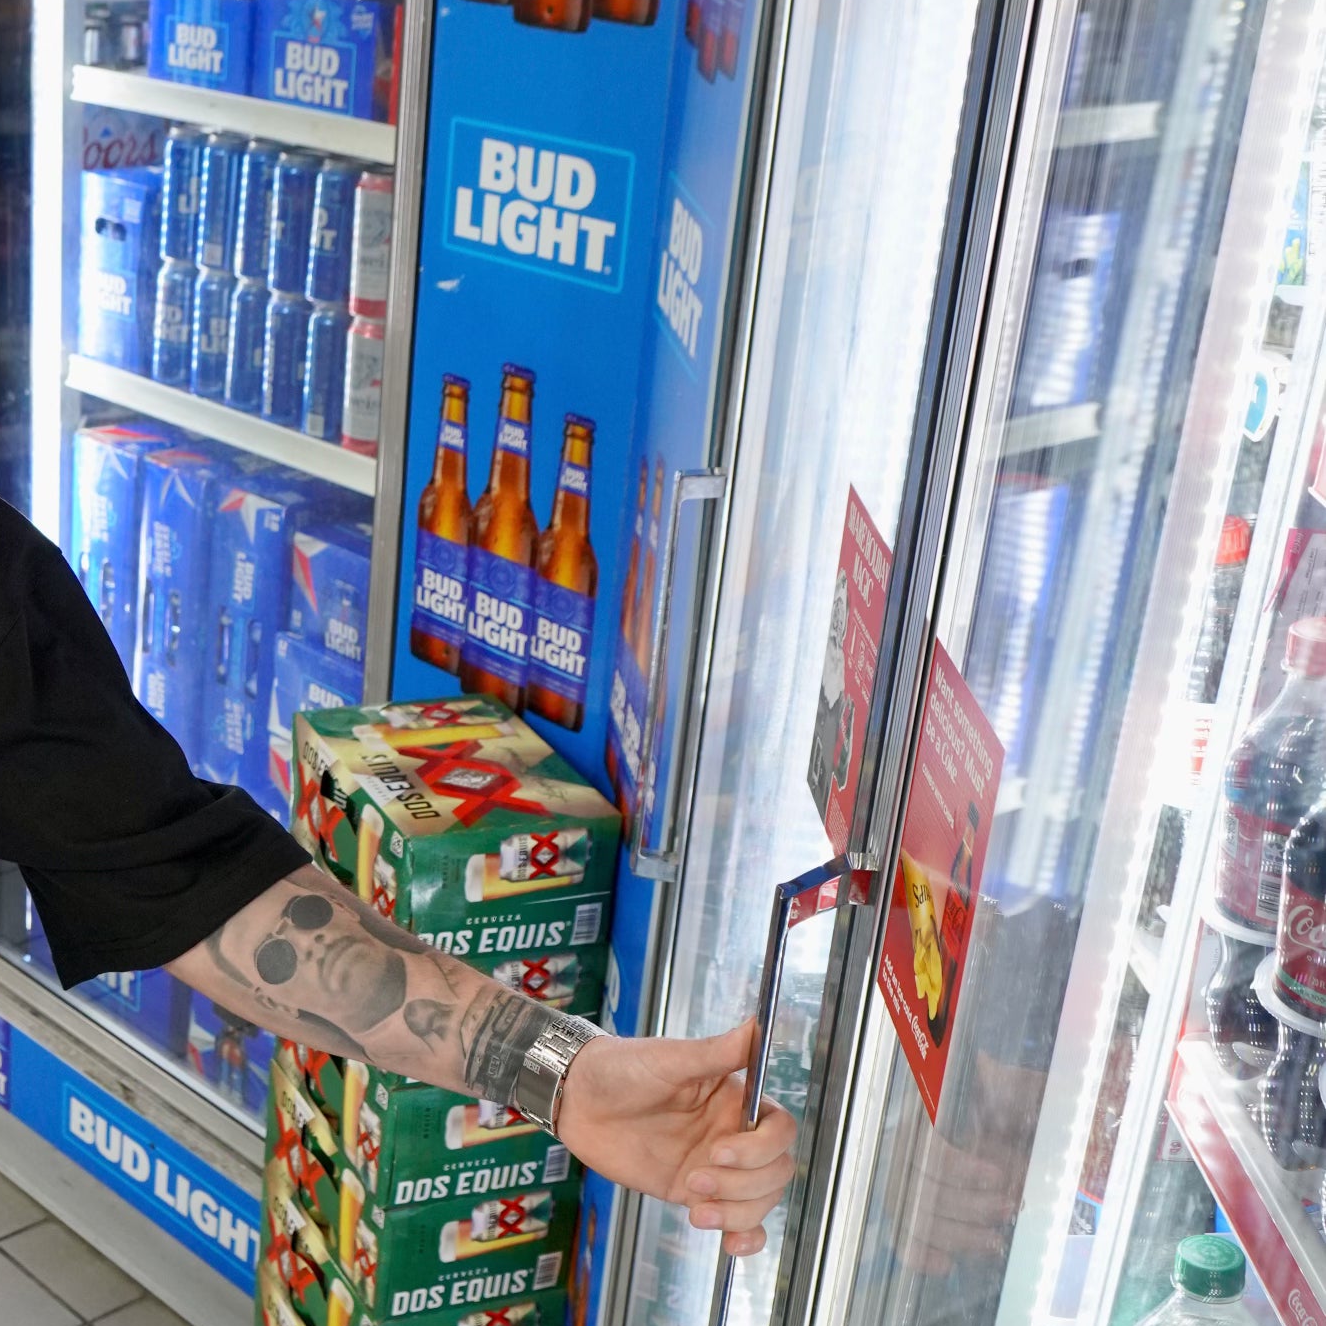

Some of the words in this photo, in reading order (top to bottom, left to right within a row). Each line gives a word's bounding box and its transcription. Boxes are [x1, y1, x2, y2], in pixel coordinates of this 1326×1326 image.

[176, 23, 217, 46] BUD
[167, 43, 224, 73] LIGHT
[284, 41, 341, 77] BUD
[274, 69, 349, 110] LIGHT
[478, 137, 597, 211] BUD
[454, 186, 616, 274] LIGHT
[669, 197, 704, 285] BUD
[657, 250, 704, 359] LIGHT
[422, 567, 463, 599] BUD
[416, 586, 467, 624] LIGHT
[476, 593, 523, 631] BUD
[467, 612, 528, 657] LIGHT
[537, 616, 583, 654] BUD
[530, 635, 586, 678] LIGHT
[934, 662, 955, 709] Want
[953, 702, 994, 780] something
[925, 714, 936, 744] be
[934, 739, 942, 756] a
[940, 742, 958, 785] Coke
[930, 691, 966, 761] delicious?
[964, 748, 986, 799] Must
[397, 791, 442, 820] DOS
[466, 913, 522, 926] CERVEZA
[477, 921, 566, 954] EQUIS
[69, 1096, 151, 1183] BUD
[394, 1173, 451, 1206] DOS
[455, 1161, 540, 1196] EQUIS
[391, 1284, 446, 1317] DOS
[449, 1270, 530, 1306] EQUIS
